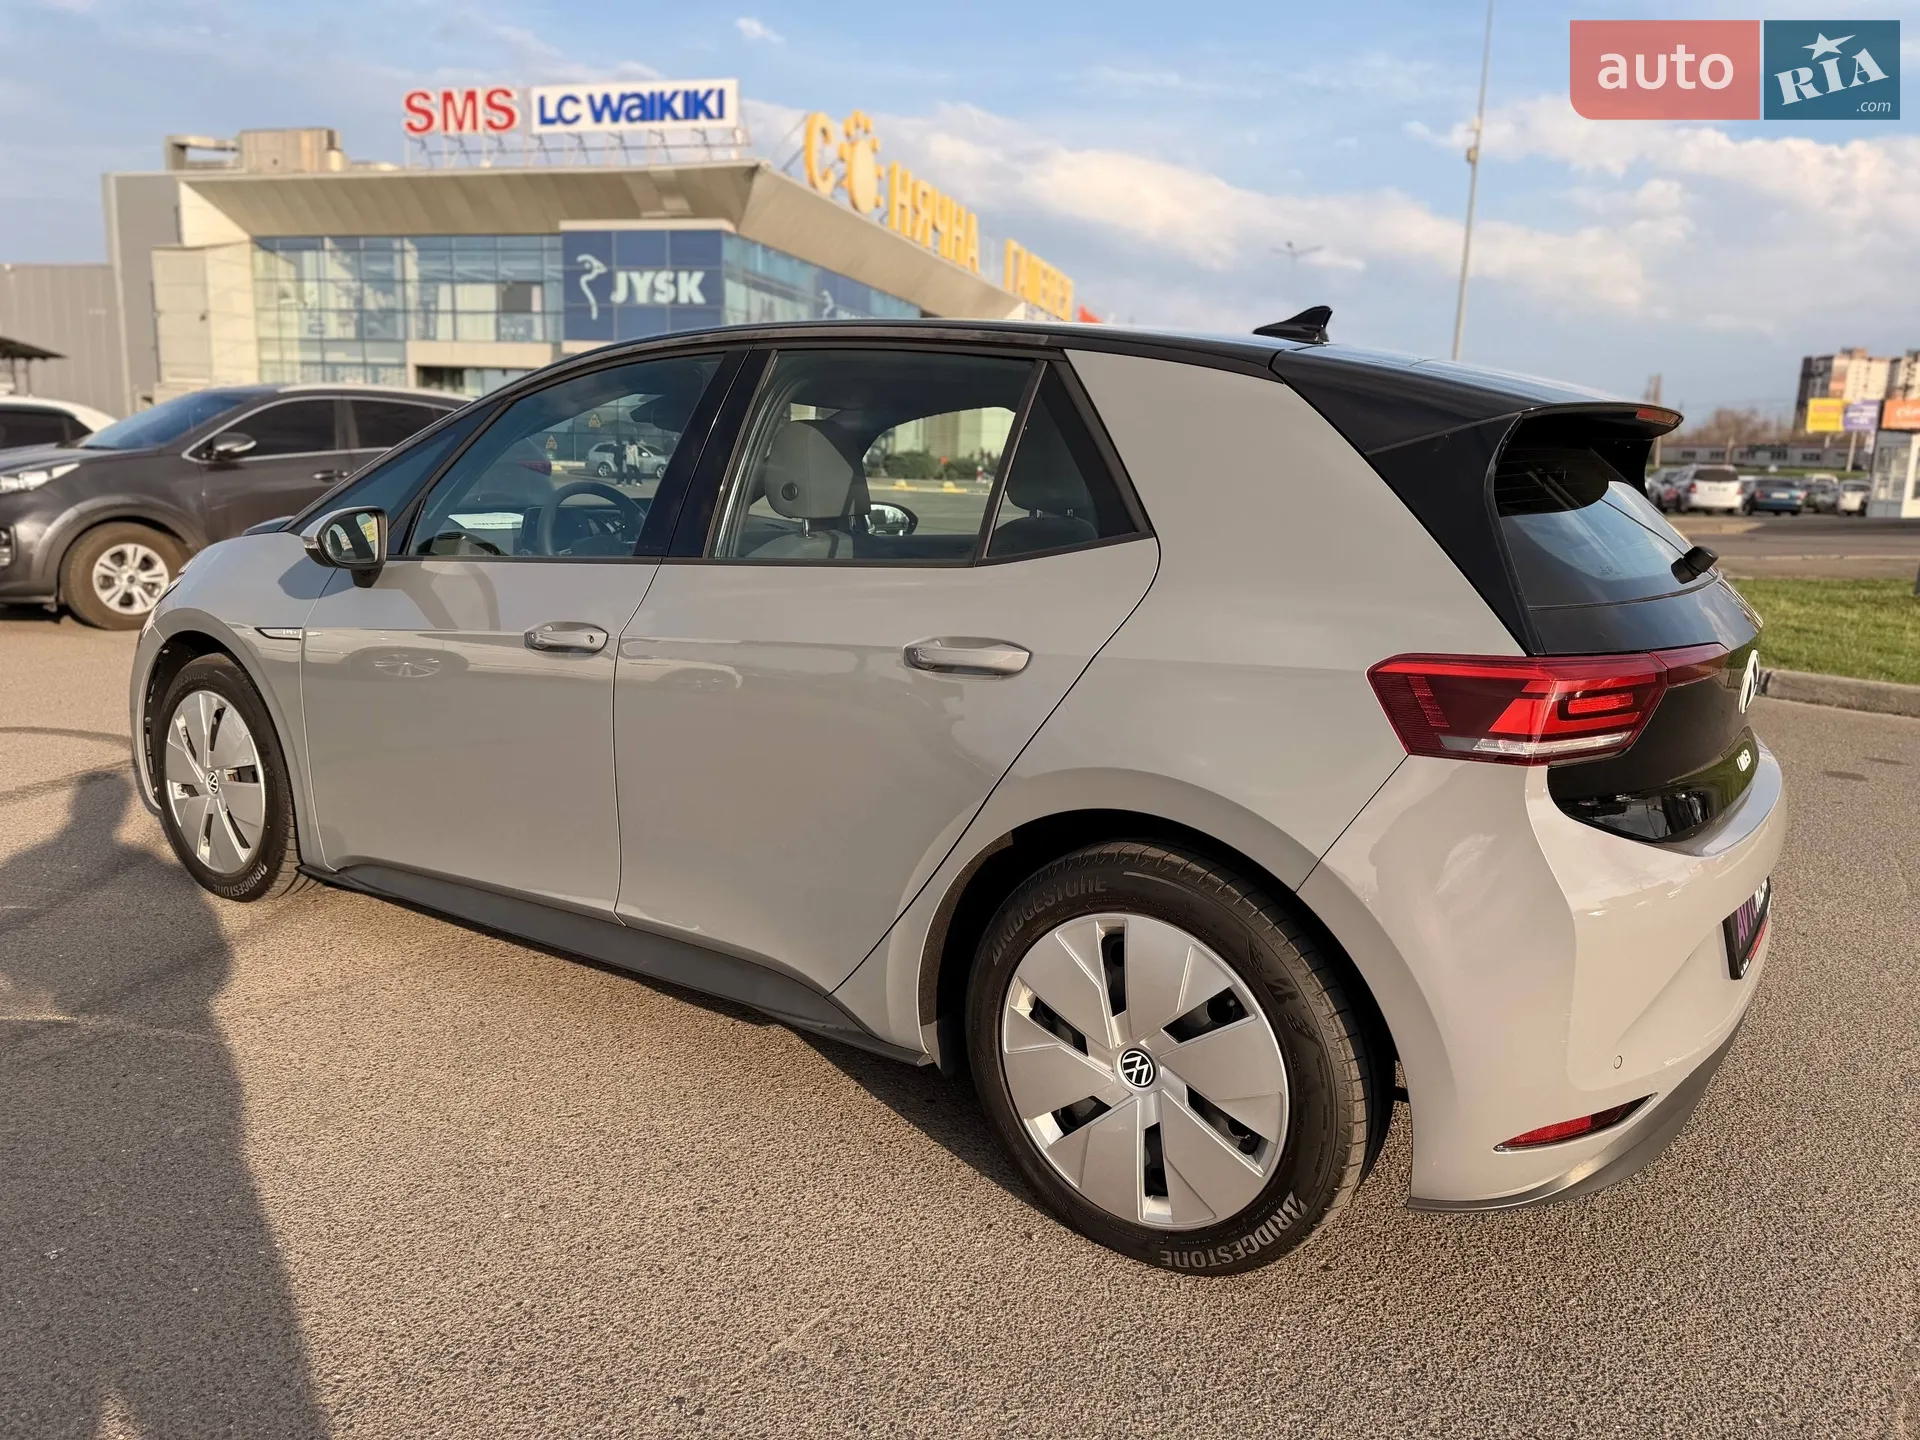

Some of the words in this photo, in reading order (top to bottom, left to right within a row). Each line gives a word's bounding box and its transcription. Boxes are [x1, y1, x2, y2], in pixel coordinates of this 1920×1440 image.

[404, 88, 518, 134] SMS
[538, 94, 582, 126] LC
[610, 271, 706, 304] JYSK
[1159, 1191, 1309, 1269] BRIDGESTONE
